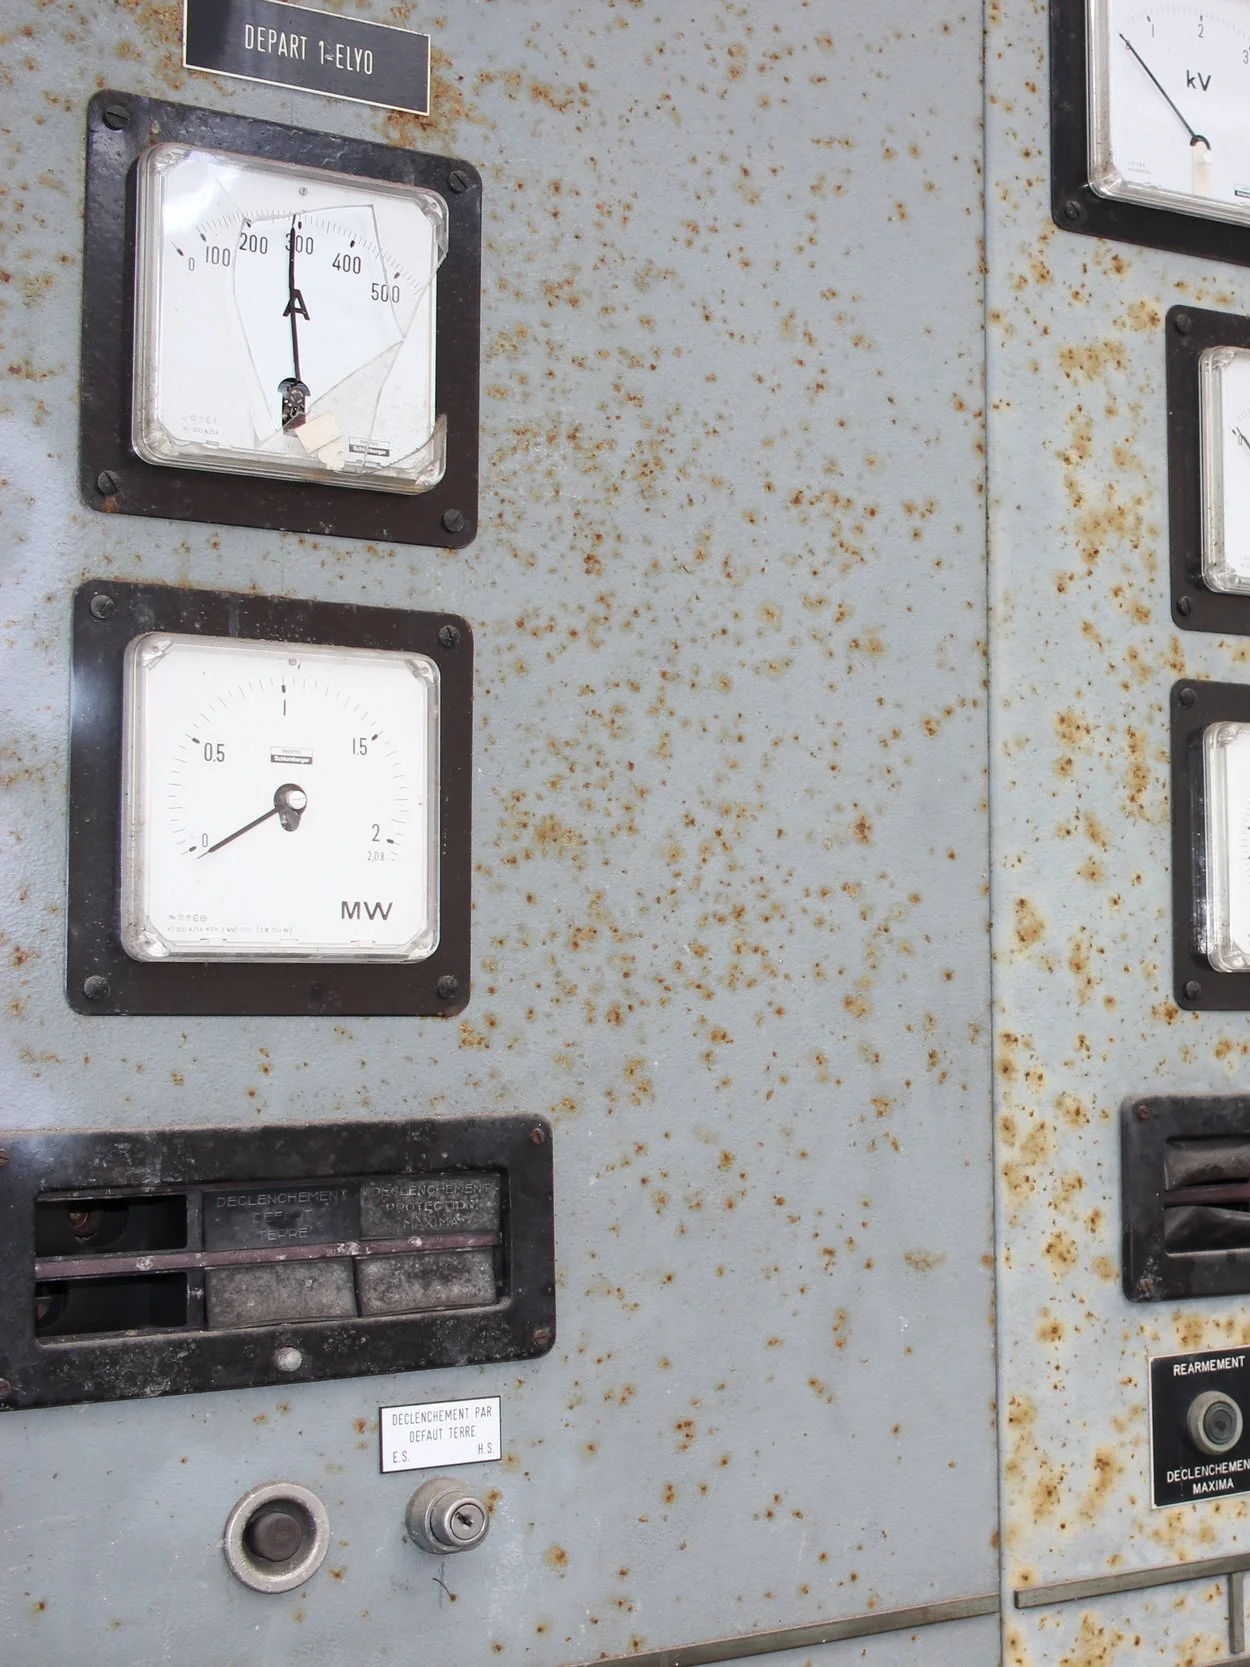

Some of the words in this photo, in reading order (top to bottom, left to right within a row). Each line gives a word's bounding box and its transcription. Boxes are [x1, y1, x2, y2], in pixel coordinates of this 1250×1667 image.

[244, 23, 308, 61] DEPART
[1197, 23, 1204, 39] 2
[1242, 49, 1249, 65] 3
[1186, 69, 1212, 92] kV
[239, 232, 269, 255] 200
[187, 256, 196, 272] 0
[205, 245, 232, 268] 100
[331, 252, 362, 275] 400
[370, 282, 401, 304] 500
[283, 287, 311, 322] A
[203, 741, 226, 764] 0.5
[201, 833, 209, 848] 0
[371, 823, 381, 843] 2
[340, 900, 394, 922] MW
[215, 1188, 349, 1209] DECLENCHEMENT
[1173, 1355, 1247, 1377] REARMEMENT
[391, 1407, 470, 1427] DECLENCHEMENT
[474, 1405, 493, 1419] PAR
[409, 1428, 444, 1444] DEFAUT
[449, 1424, 476, 1440] TERRE
[1192, 1477, 1235, 1496] MAXIMA
